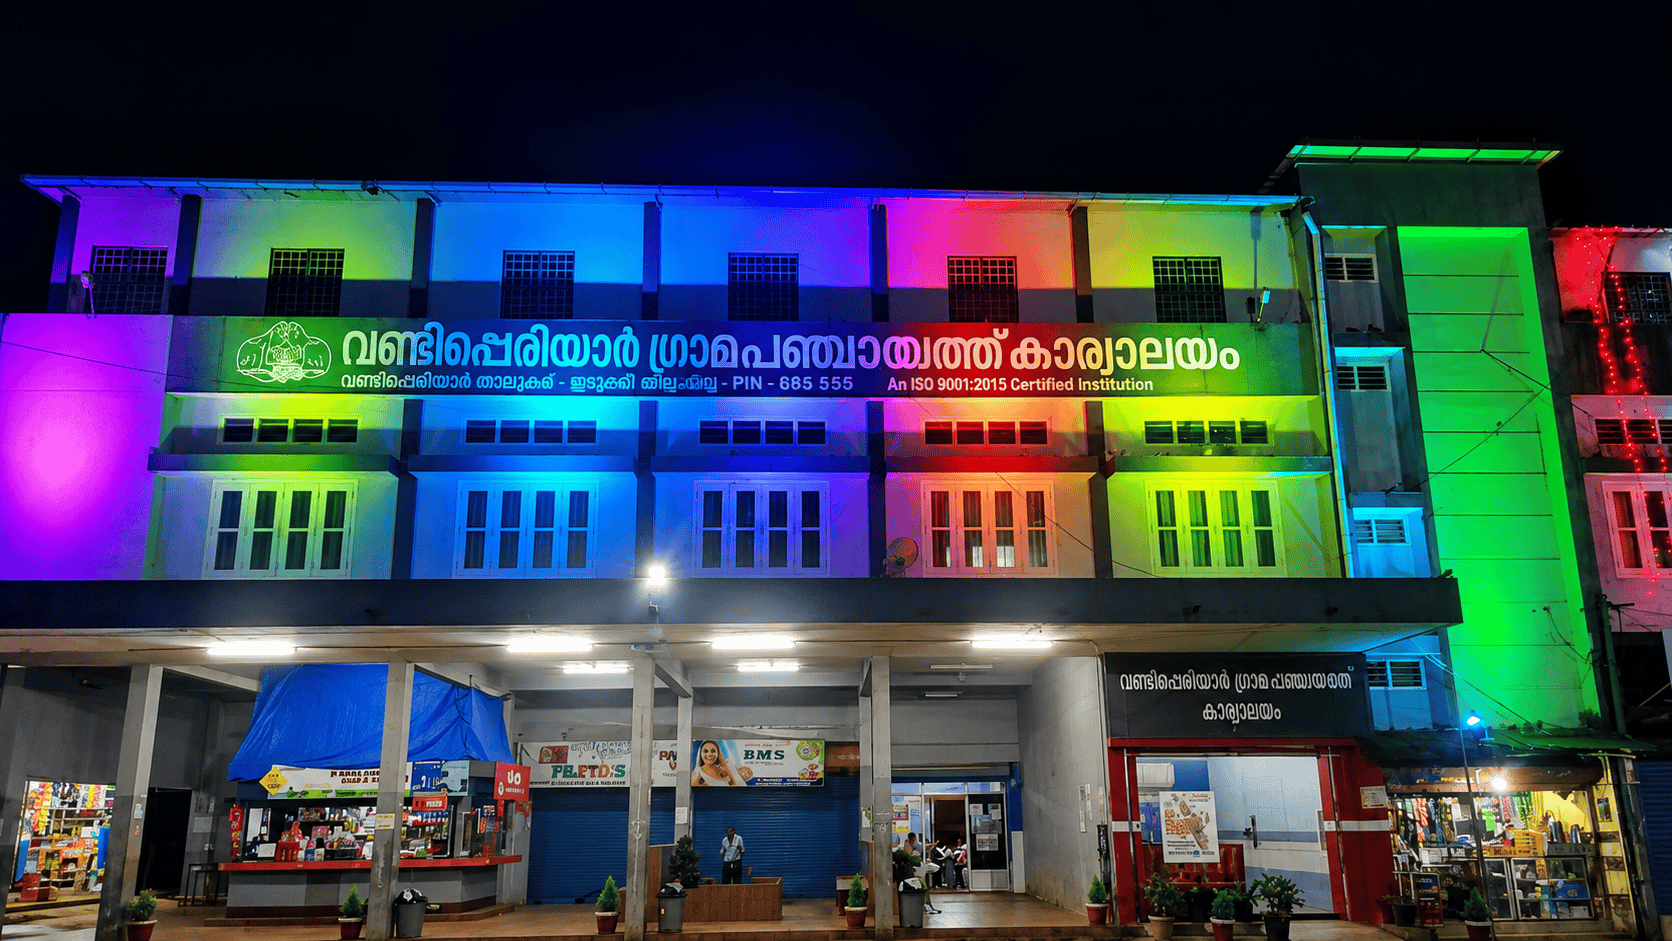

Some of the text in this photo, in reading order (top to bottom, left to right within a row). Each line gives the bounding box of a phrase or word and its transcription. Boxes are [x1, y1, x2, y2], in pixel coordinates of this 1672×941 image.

[342, 321, 640, 367] വണ്ടിപ്പെരിയാർ
[1010, 336, 1241, 375] കാര്യാലയം
[341, 371, 471, 388] വണ്ടിപ്പെരിയാർ
[733, 376, 763, 390] PIN
[779, 376, 813, 390] 685
[819, 376, 853, 390] 555
[887, 376, 1153, 391] An ISO 9001:2015 Certified Institution
[1119, 669, 1231, 690] വണ്ടിപ്പെരിയാർ
[1202, 702, 1282, 724] കാര്യാലയം
[743, 749, 785, 760] BMS
